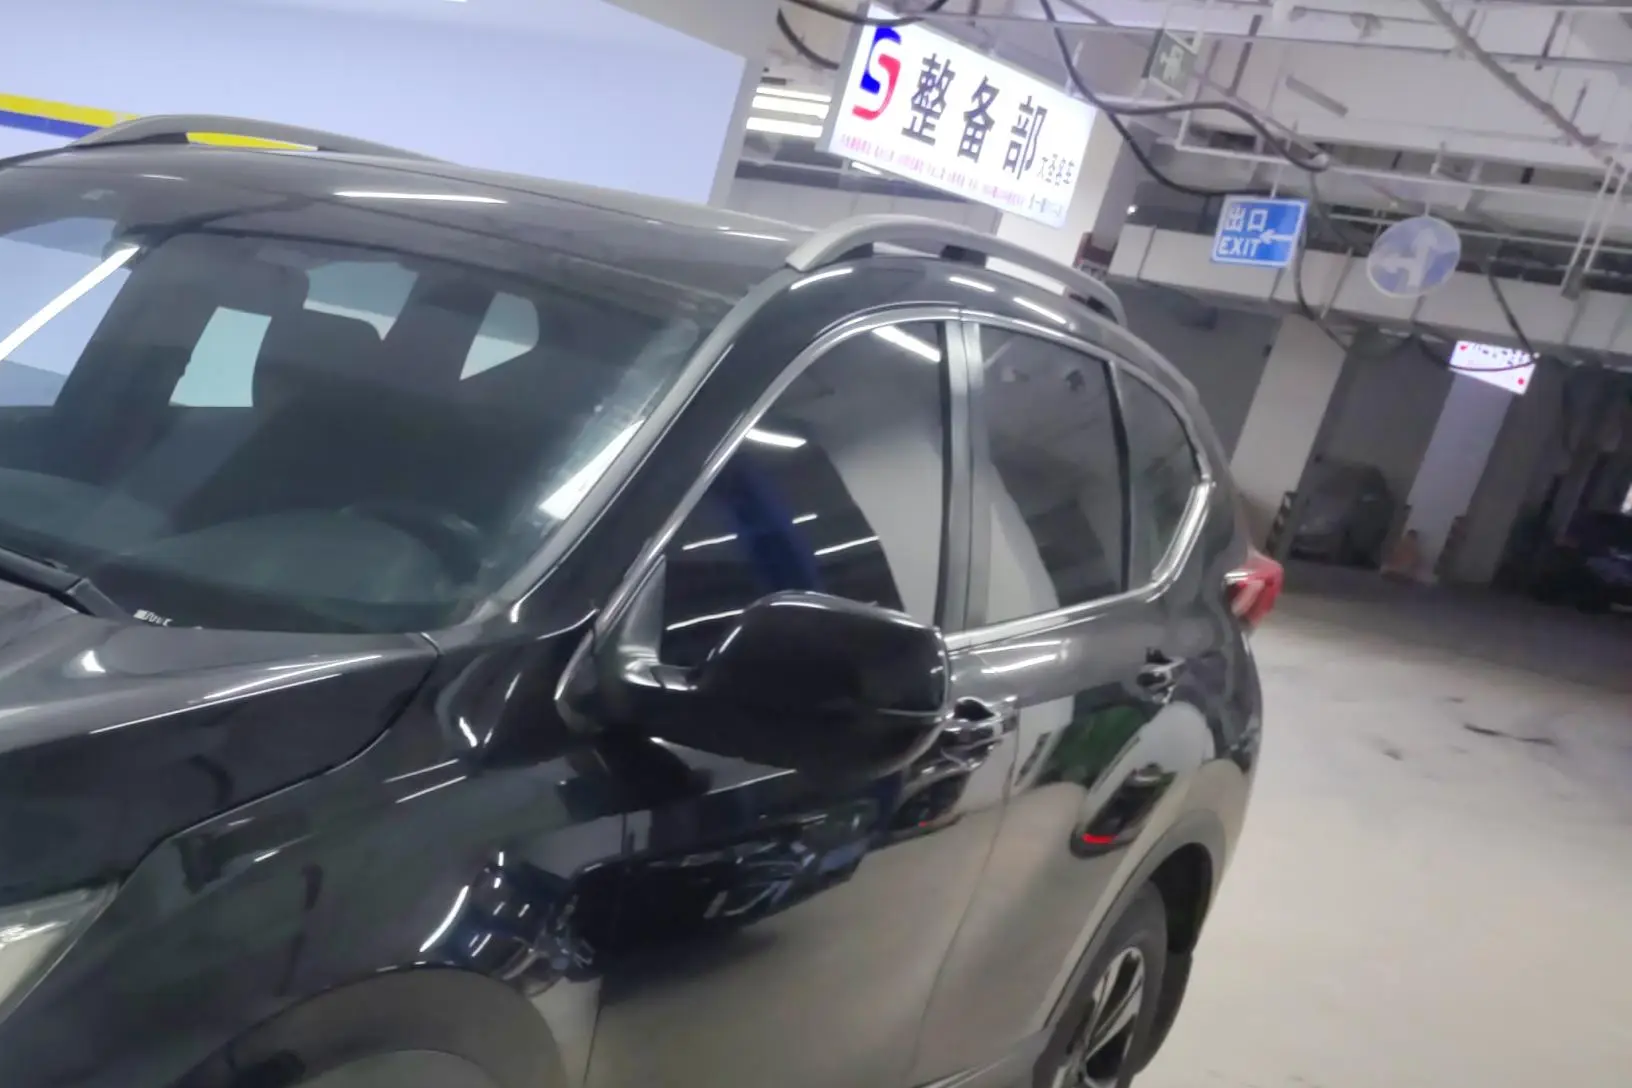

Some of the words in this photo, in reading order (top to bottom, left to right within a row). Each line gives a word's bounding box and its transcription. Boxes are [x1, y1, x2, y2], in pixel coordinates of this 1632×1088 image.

[900, 53, 1048, 181] 整备部
[1225, 206, 1268, 232] 出口
[1218, 236, 1262, 257] EXIT
